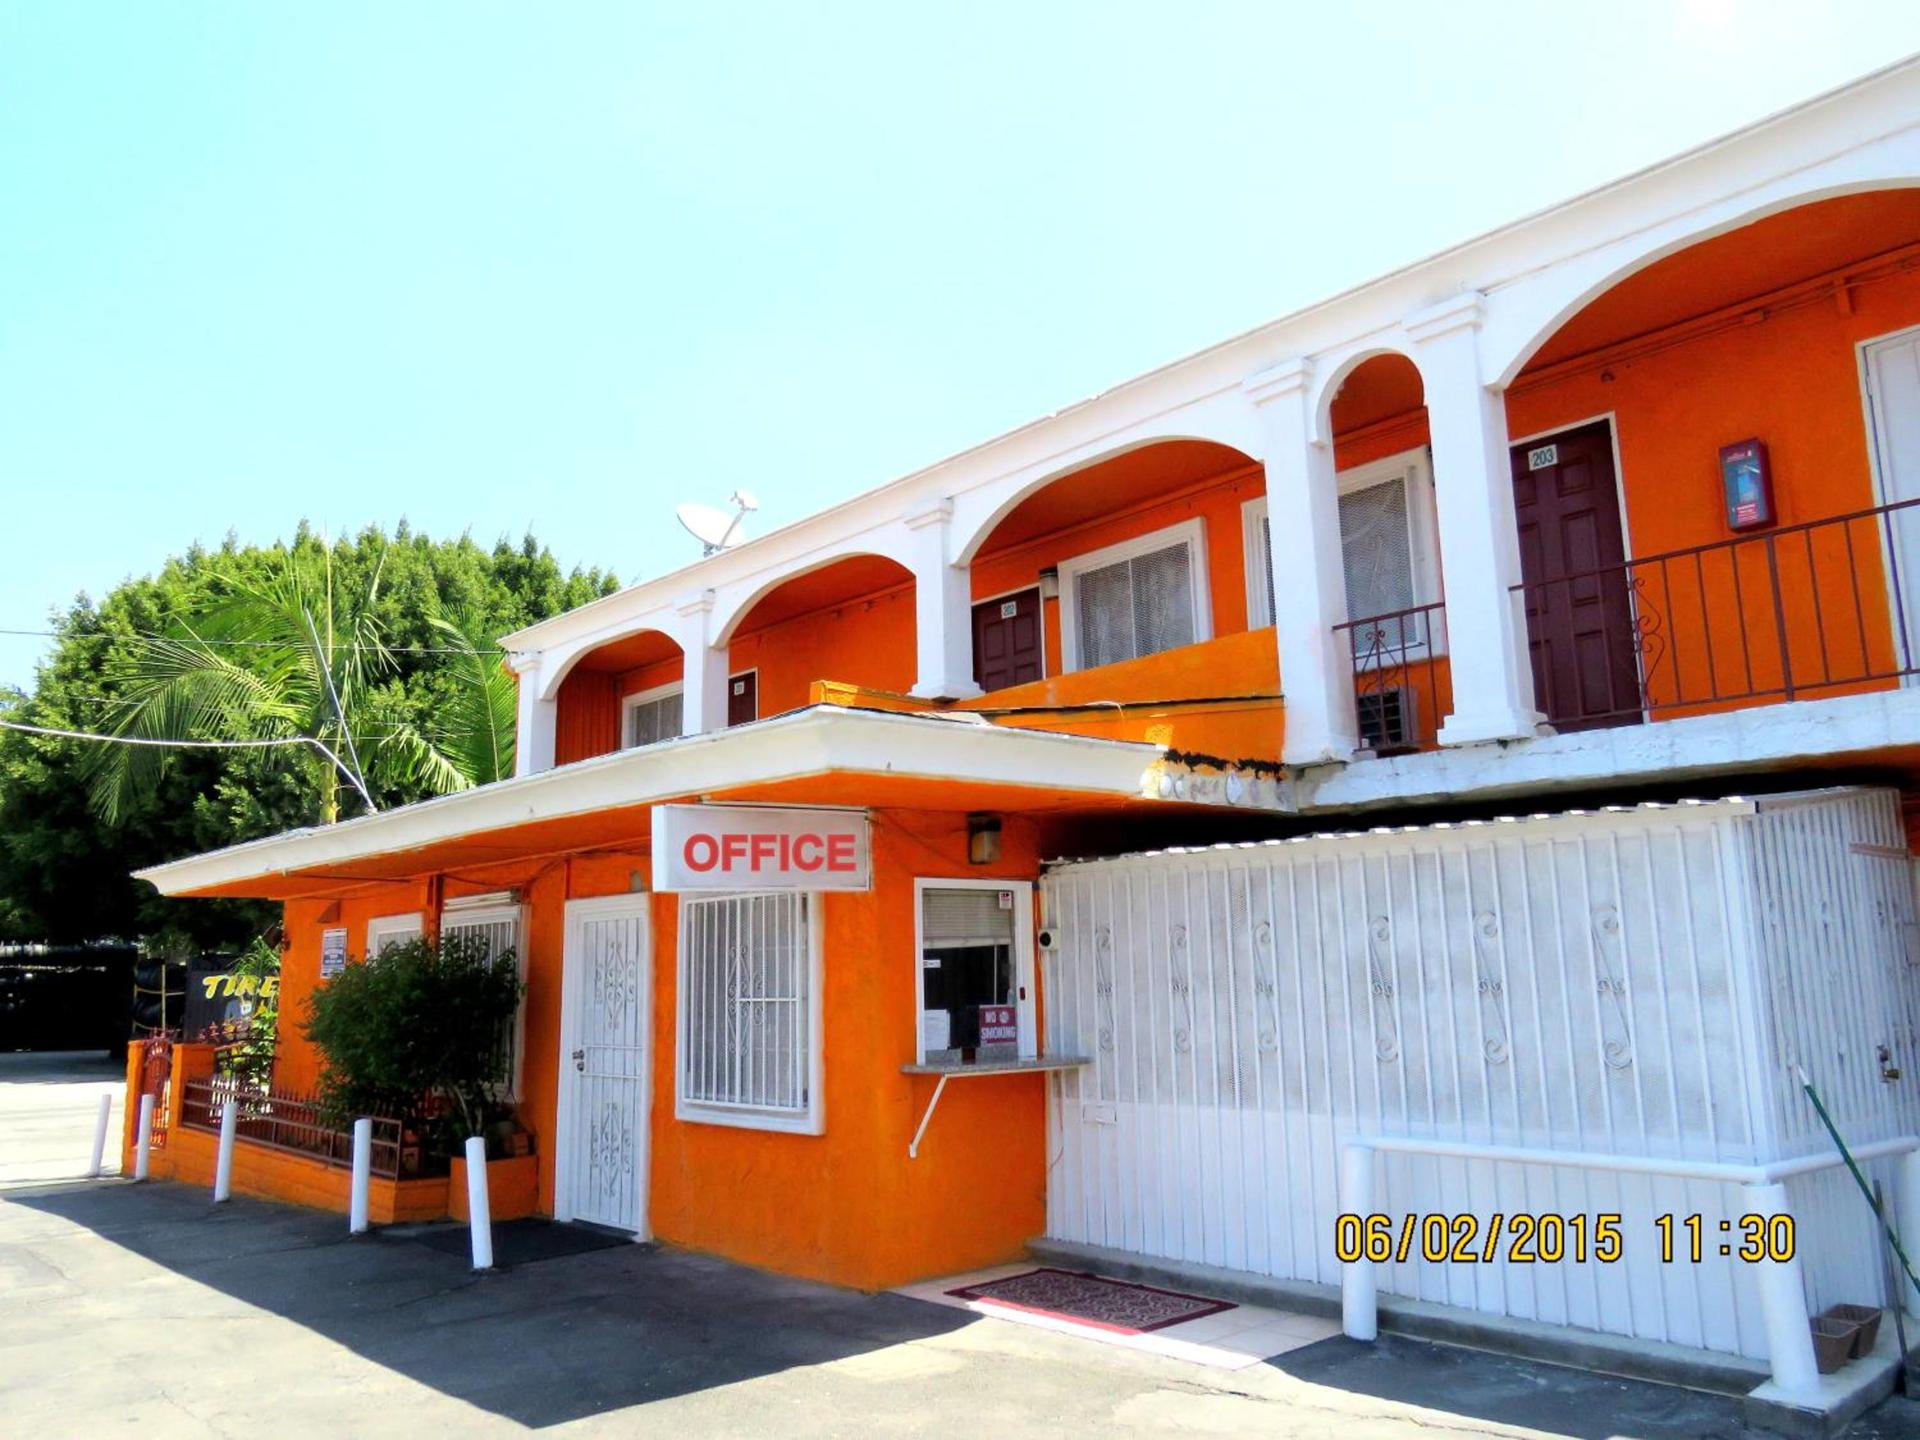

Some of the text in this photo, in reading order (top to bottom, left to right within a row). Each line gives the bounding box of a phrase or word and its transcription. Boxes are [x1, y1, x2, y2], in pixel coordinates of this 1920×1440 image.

[1532, 447, 1554, 467] 203
[683, 833, 857, 872] OFFICE
[981, 1026, 1016, 1040] SMOKING
